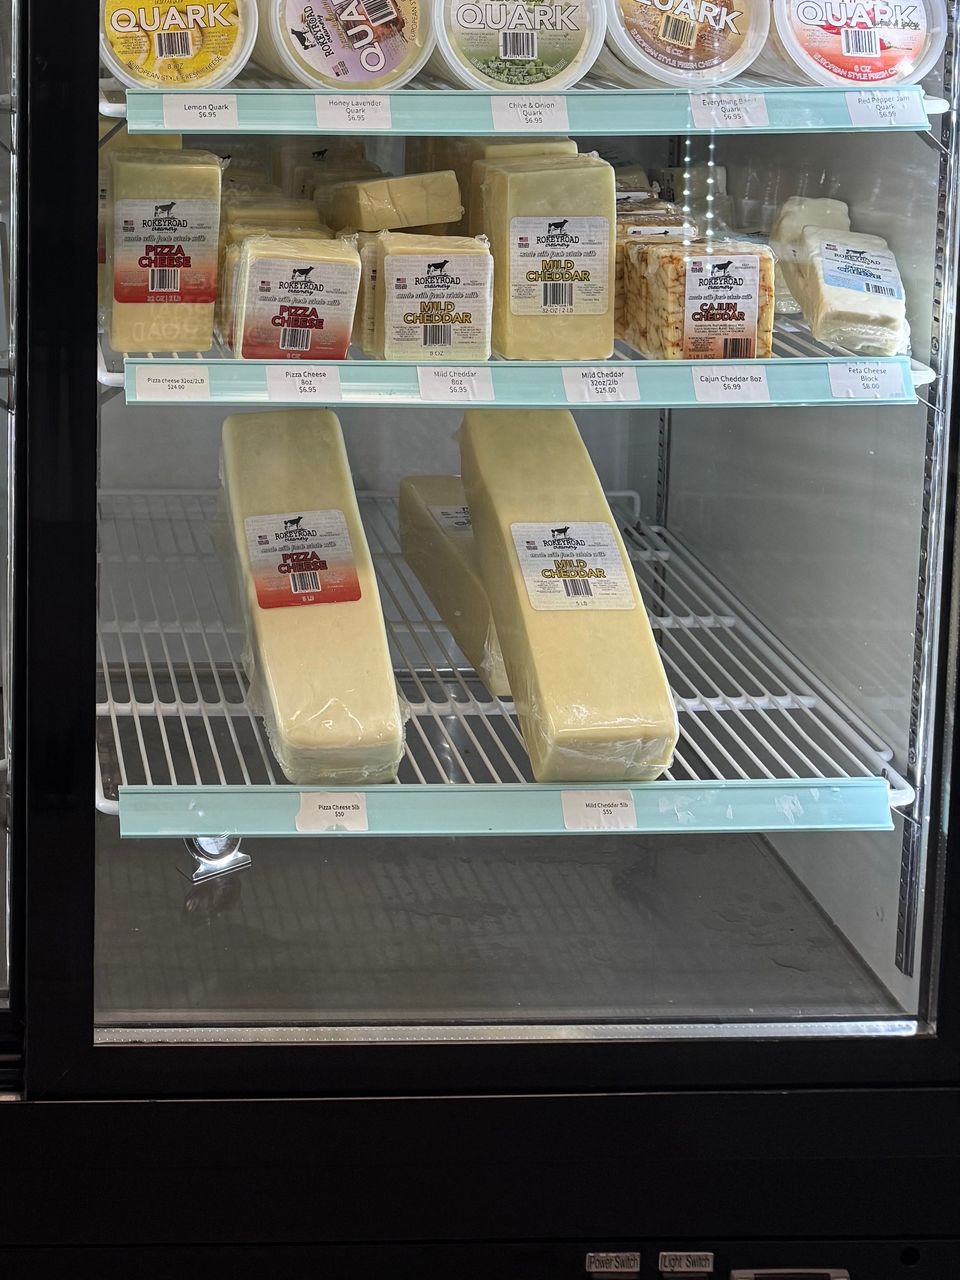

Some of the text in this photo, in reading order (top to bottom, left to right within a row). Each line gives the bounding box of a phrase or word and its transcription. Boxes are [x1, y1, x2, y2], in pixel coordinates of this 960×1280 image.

[110, 2, 232, 33] QUARK
[456, 4, 580, 31] QUARK
[796, 0, 920, 30] QUARK
[303, 5, 335, 58] ROKEYROAD
[142, 219, 188, 228] ROKEYROAD
[536, 236, 580, 245] ROKEYROAD
[145, 244, 186, 256] PIZZA
[138, 256, 192, 268] CHEESE
[542, 260, 574, 271] MILD
[414, 276, 460, 286] ROKEYROAD
[526, 270, 590, 282] CHEDDAR
[698, 277, 743, 287] ROKEYROAD
[278, 281, 324, 292] ROKEYROAD
[279, 305, 319, 318] PIZZA
[420, 302, 455, 313] MILD
[700, 303, 737, 312] CAJUN
[403, 312, 472, 324] CHEDDAR
[692, 311, 745, 322] CHEDDAR
[271, 316, 324, 330] CHEESE
[275, 530, 317, 540] ROKEYROAD
[542, 539, 585, 547] ROKEYROAD
[282, 551, 321, 563] PIZZA
[278, 560, 328, 574] CHEESE
[554, 559, 587, 570] MILD
[541, 568, 606, 579] CHEDDAR
[589, 1255, 638, 1270] Power Switch
[663, 1255, 710, 1271] Light Switch
